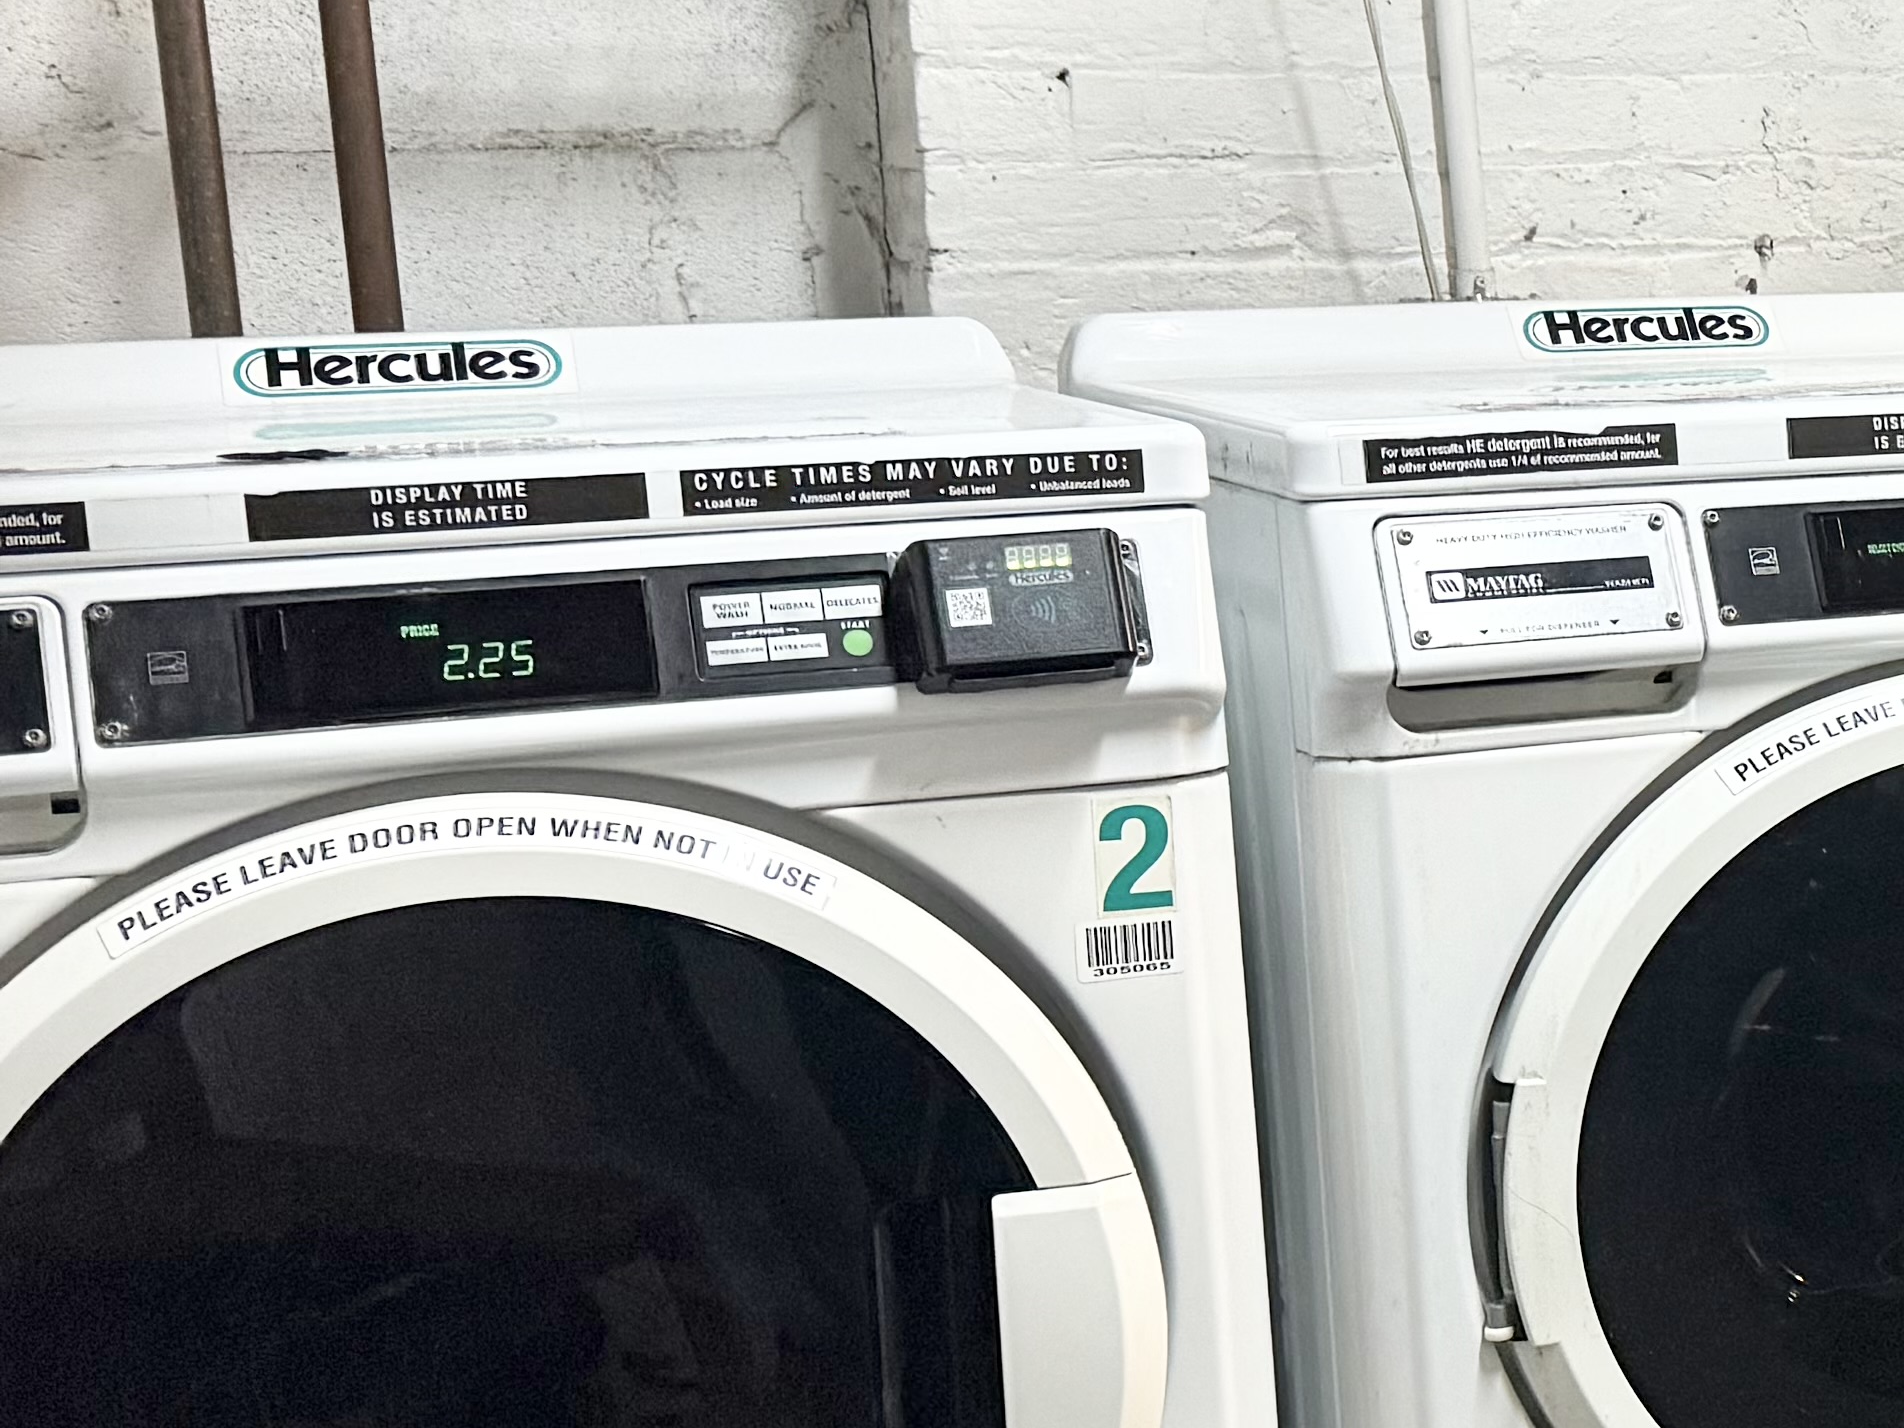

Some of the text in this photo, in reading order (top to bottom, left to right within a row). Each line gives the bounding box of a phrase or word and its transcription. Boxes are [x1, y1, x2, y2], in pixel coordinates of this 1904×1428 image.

[1541, 307, 1754, 345] Hercules
[262, 342, 540, 388] Hercules
[1380, 446, 1399, 460] For
[1466, 439, 1486, 454] HE
[1874, 435, 1890, 450] IS
[693, 452, 1130, 492] CYCLE TIMES MAY VARY DUE TO:
[1398, 461, 1426, 474] other
[370, 480, 528, 506] DISPLAY TIME
[800, 487, 911, 505] Amount of detergent
[970, 482, 996, 496] level
[703, 498, 733, 510] Load
[41, 511, 64, 526] for
[372, 504, 528, 529] IS ESTIMATED
[5, 531, 67, 547] amount.
[1465, 572, 1544, 594] MAYTAG
[400, 623, 440, 638] PRICE
[442, 639, 535, 681] 2.25
[1732, 727, 1821, 782] PLEASE
[1820, 700, 1897, 740] LEAVE
[1098, 804, 1174, 913] 2
[116, 815, 822, 943] PLEASE LEAVE DOOR OPEN WHEN NOT USE
[1092, 961, 1172, 978] 305065
